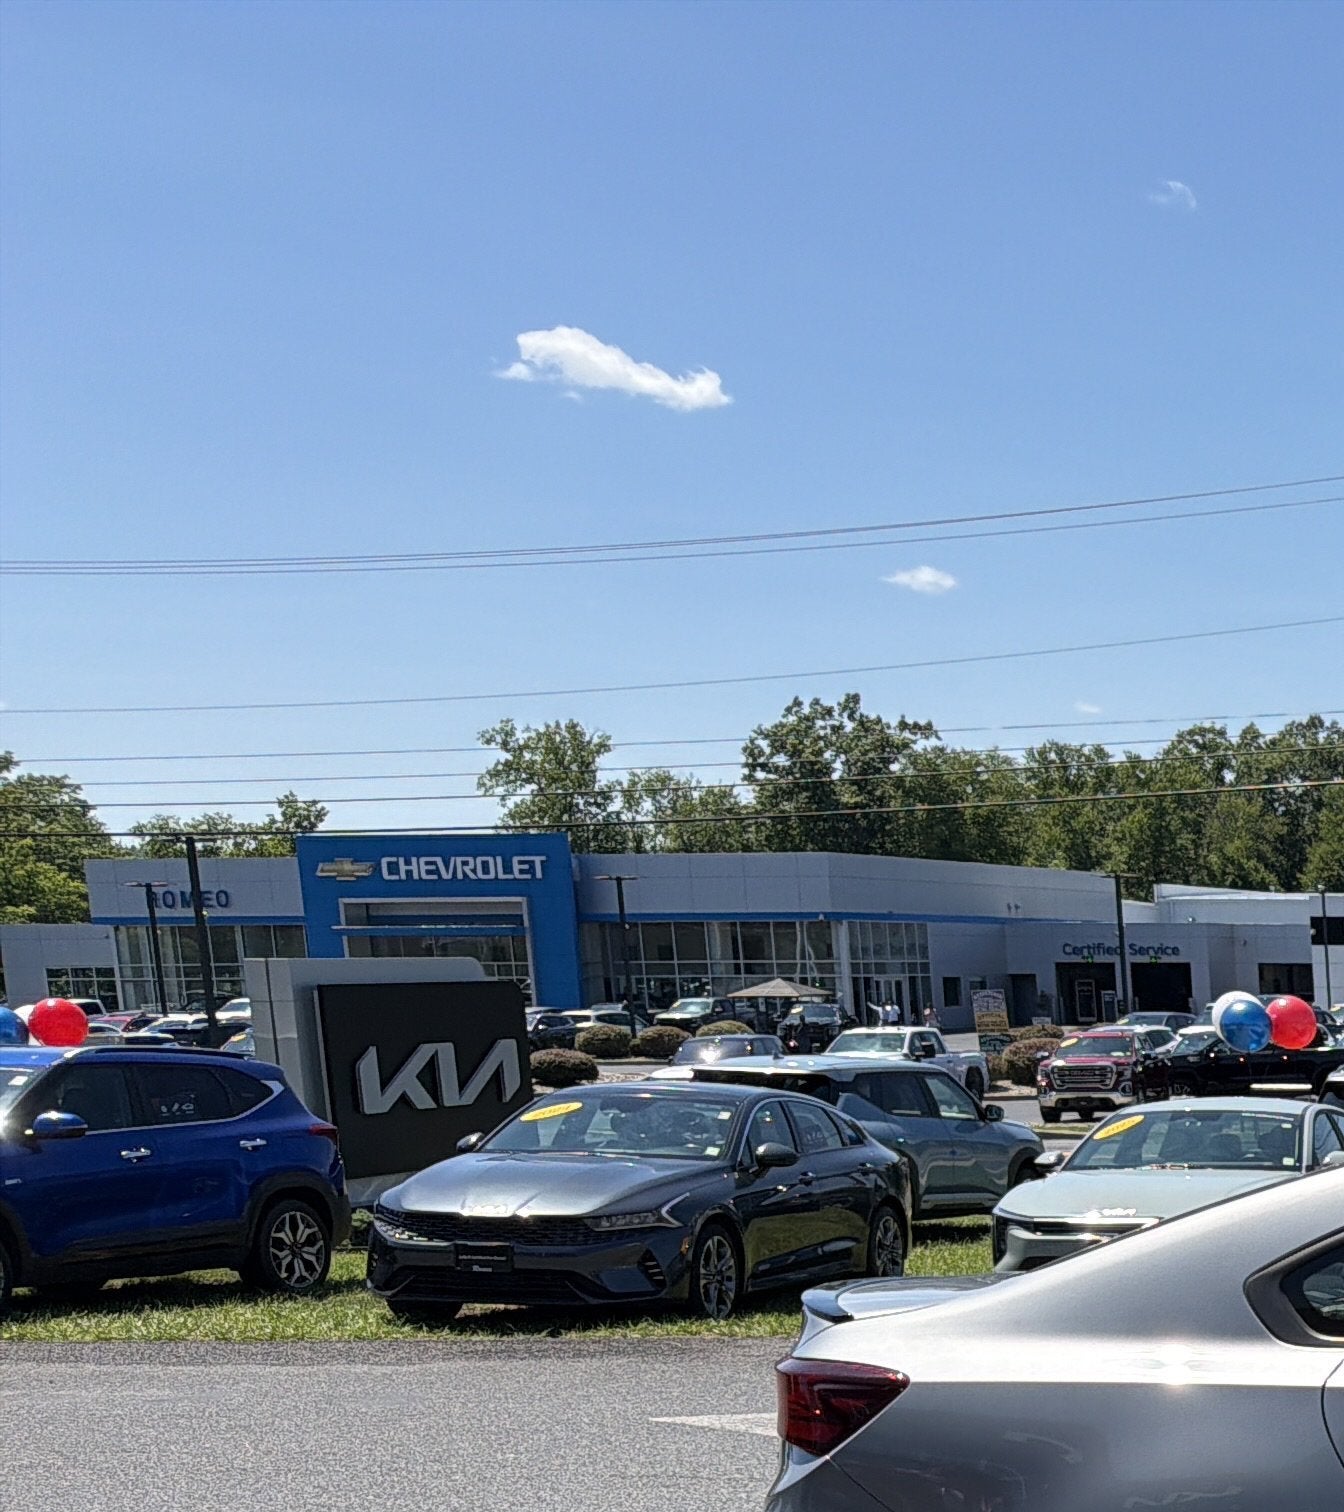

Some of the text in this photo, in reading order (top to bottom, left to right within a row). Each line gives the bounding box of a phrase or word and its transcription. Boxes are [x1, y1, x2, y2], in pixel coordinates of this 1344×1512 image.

[380, 855, 547, 880] CHEVROLET
[147, 889, 230, 910] ROMEO
[1062, 942, 1180, 956] Certified Service
[355, 1038, 521, 1115] KIA
